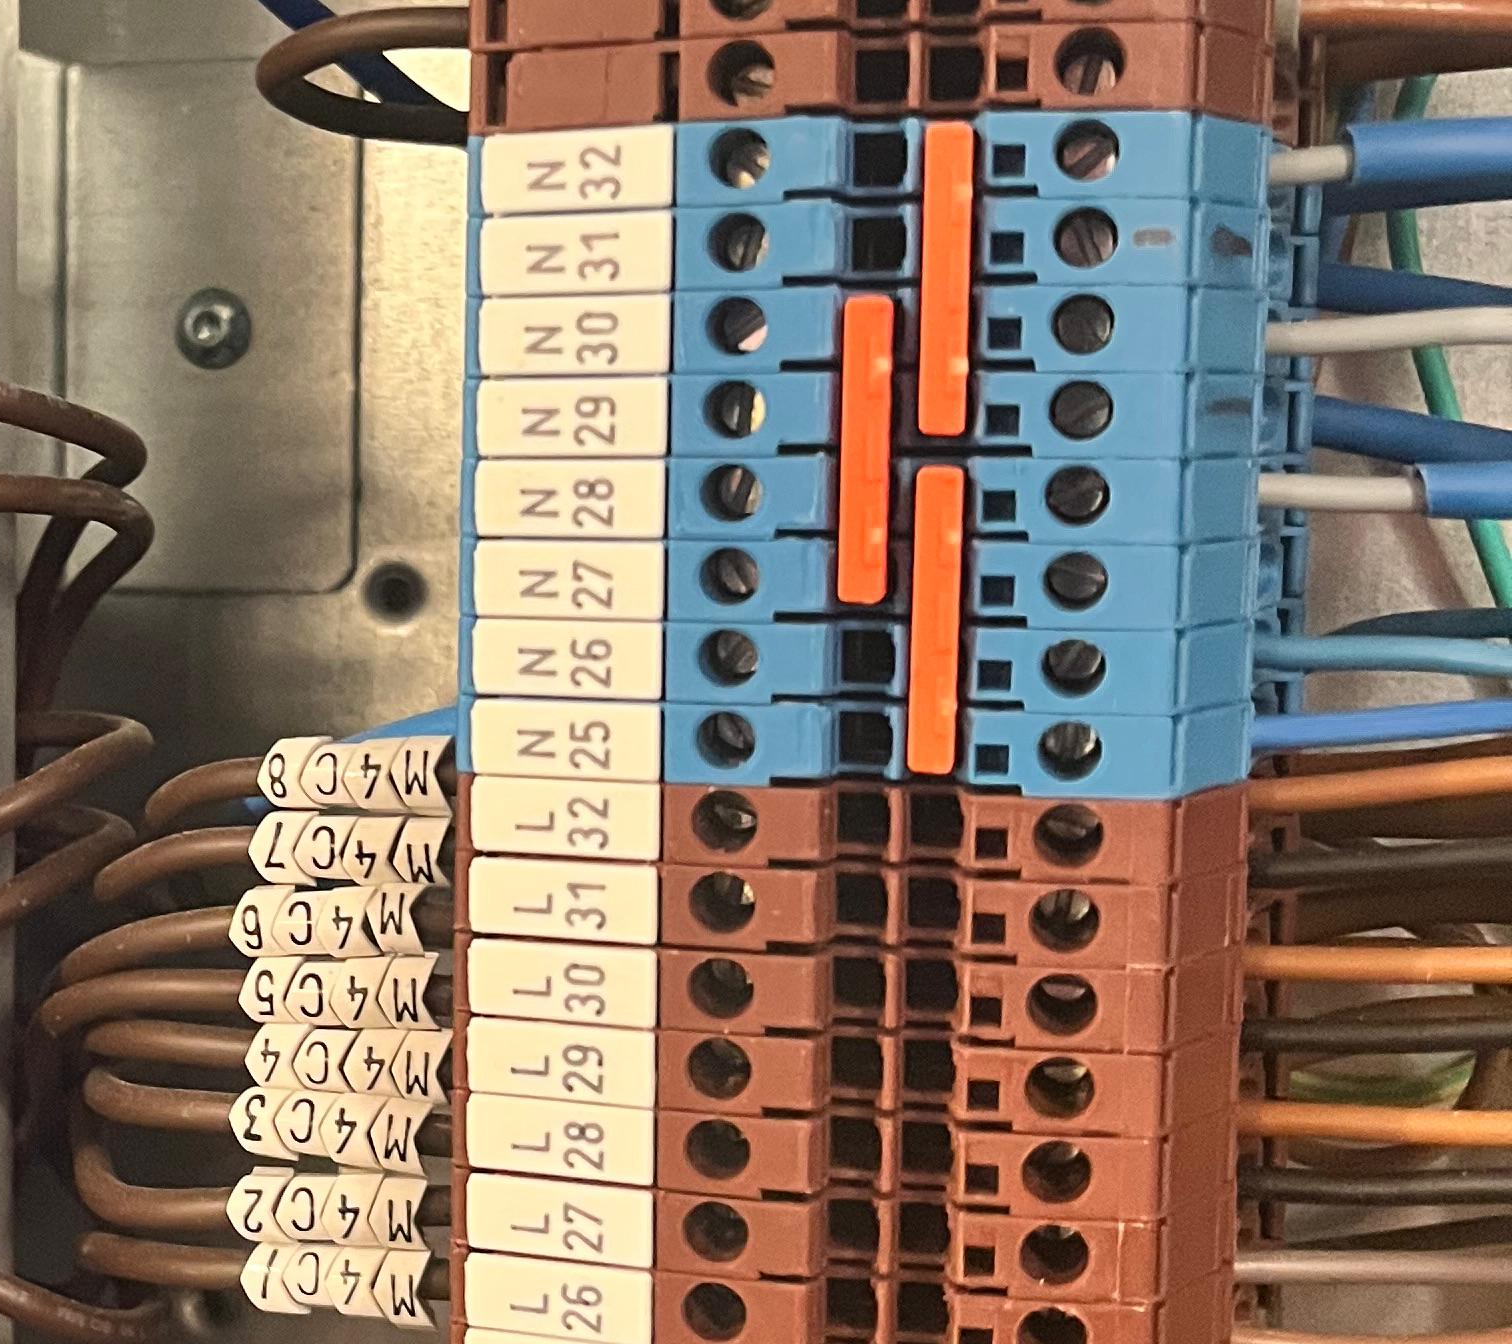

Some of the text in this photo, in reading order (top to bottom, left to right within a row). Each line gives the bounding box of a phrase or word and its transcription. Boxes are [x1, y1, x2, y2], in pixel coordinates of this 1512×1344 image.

[526, 160, 567, 191] N
[578, 144, 622, 201] 32
[525, 244, 566, 274] N
[577, 231, 621, 282] 31
[523, 326, 563, 355] N
[575, 311, 619, 366] 30
[521, 407, 561, 437] N
[573, 395, 617, 447] 29
[519, 488, 560, 519] N
[571, 478, 615, 528] 28
[518, 569, 559, 599] N
[571, 559, 614, 610] 27
[517, 647, 558, 677] N
[569, 638, 613, 689] 26
[516, 729, 557, 759] N
[568, 720, 611, 770] 25
[514, 810, 556, 832] L
[566, 797, 610, 851] 32
[512, 893, 553, 915] L
[564, 882, 607, 931] 31
[512, 975, 552, 997] L
[563, 962, 606, 1018] 30
[510, 1055, 550, 1077] L
[561, 1043, 604, 1095] 29
[510, 1131, 551, 1153] L
[562, 1121, 605, 1171] 28
[510, 1213, 550, 1235] L
[562, 1202, 604, 1254] 27
[509, 1293, 549, 1315] L
[560, 1283, 603, 1334] 26
